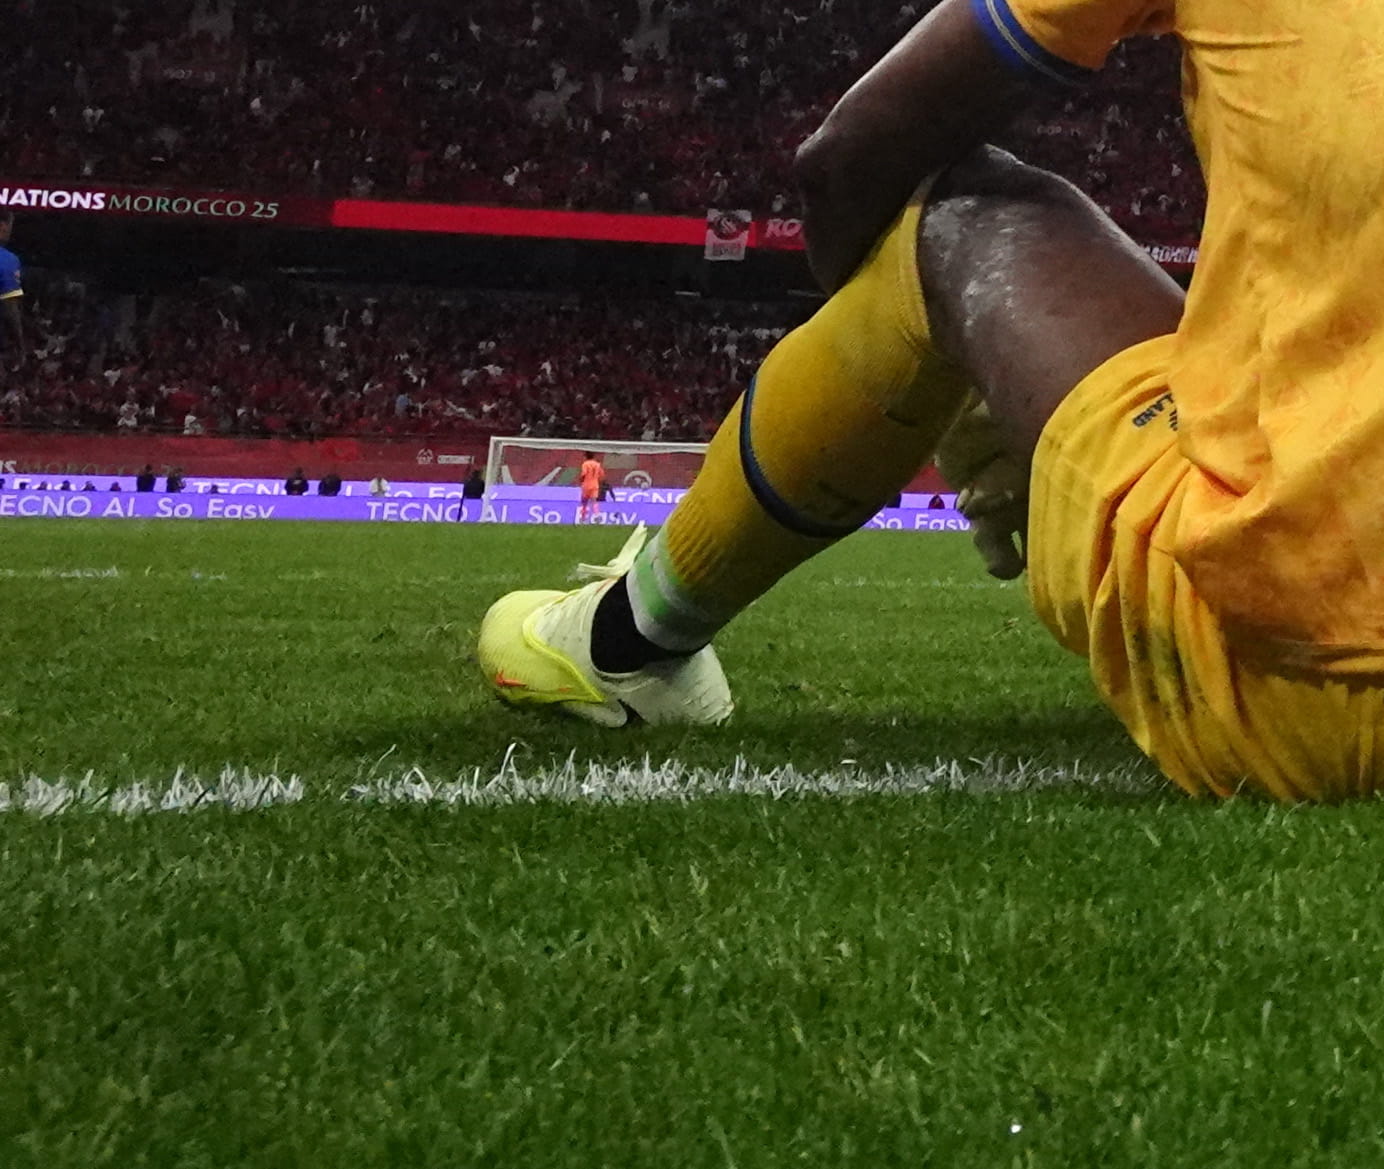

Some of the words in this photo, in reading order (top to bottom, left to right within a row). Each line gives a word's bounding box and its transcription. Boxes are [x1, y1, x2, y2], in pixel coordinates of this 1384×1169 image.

[108, 193, 246, 217] MOROCCO
[251, 201, 279, 218] 25
[0, 494, 92, 517] ECNO
[155, 497, 193, 518] So
